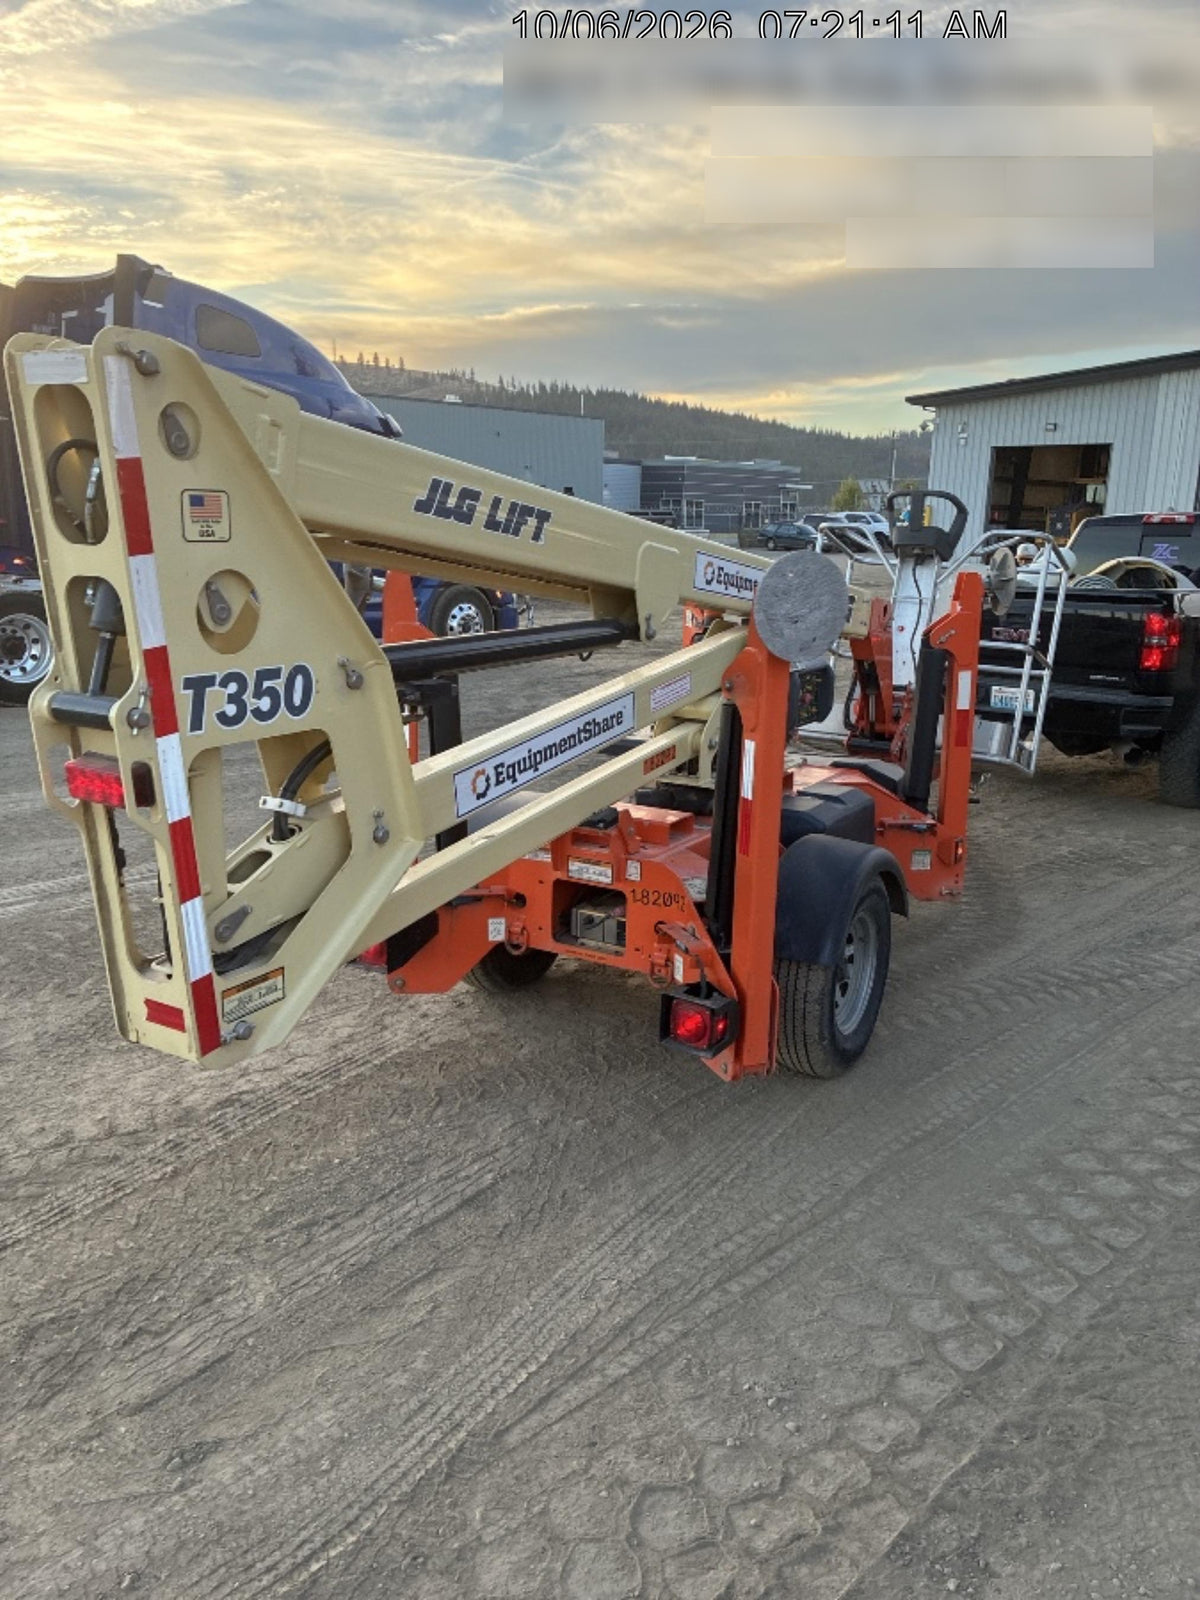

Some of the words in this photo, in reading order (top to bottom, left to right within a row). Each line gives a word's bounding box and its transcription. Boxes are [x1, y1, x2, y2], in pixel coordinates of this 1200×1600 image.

[413, 475, 484, 526] JLG
[481, 495, 552, 544] LIFT
[716, 566, 759, 593] Equipme
[180, 662, 315, 736] T350
[494, 709, 624, 788] EquipmentShare
